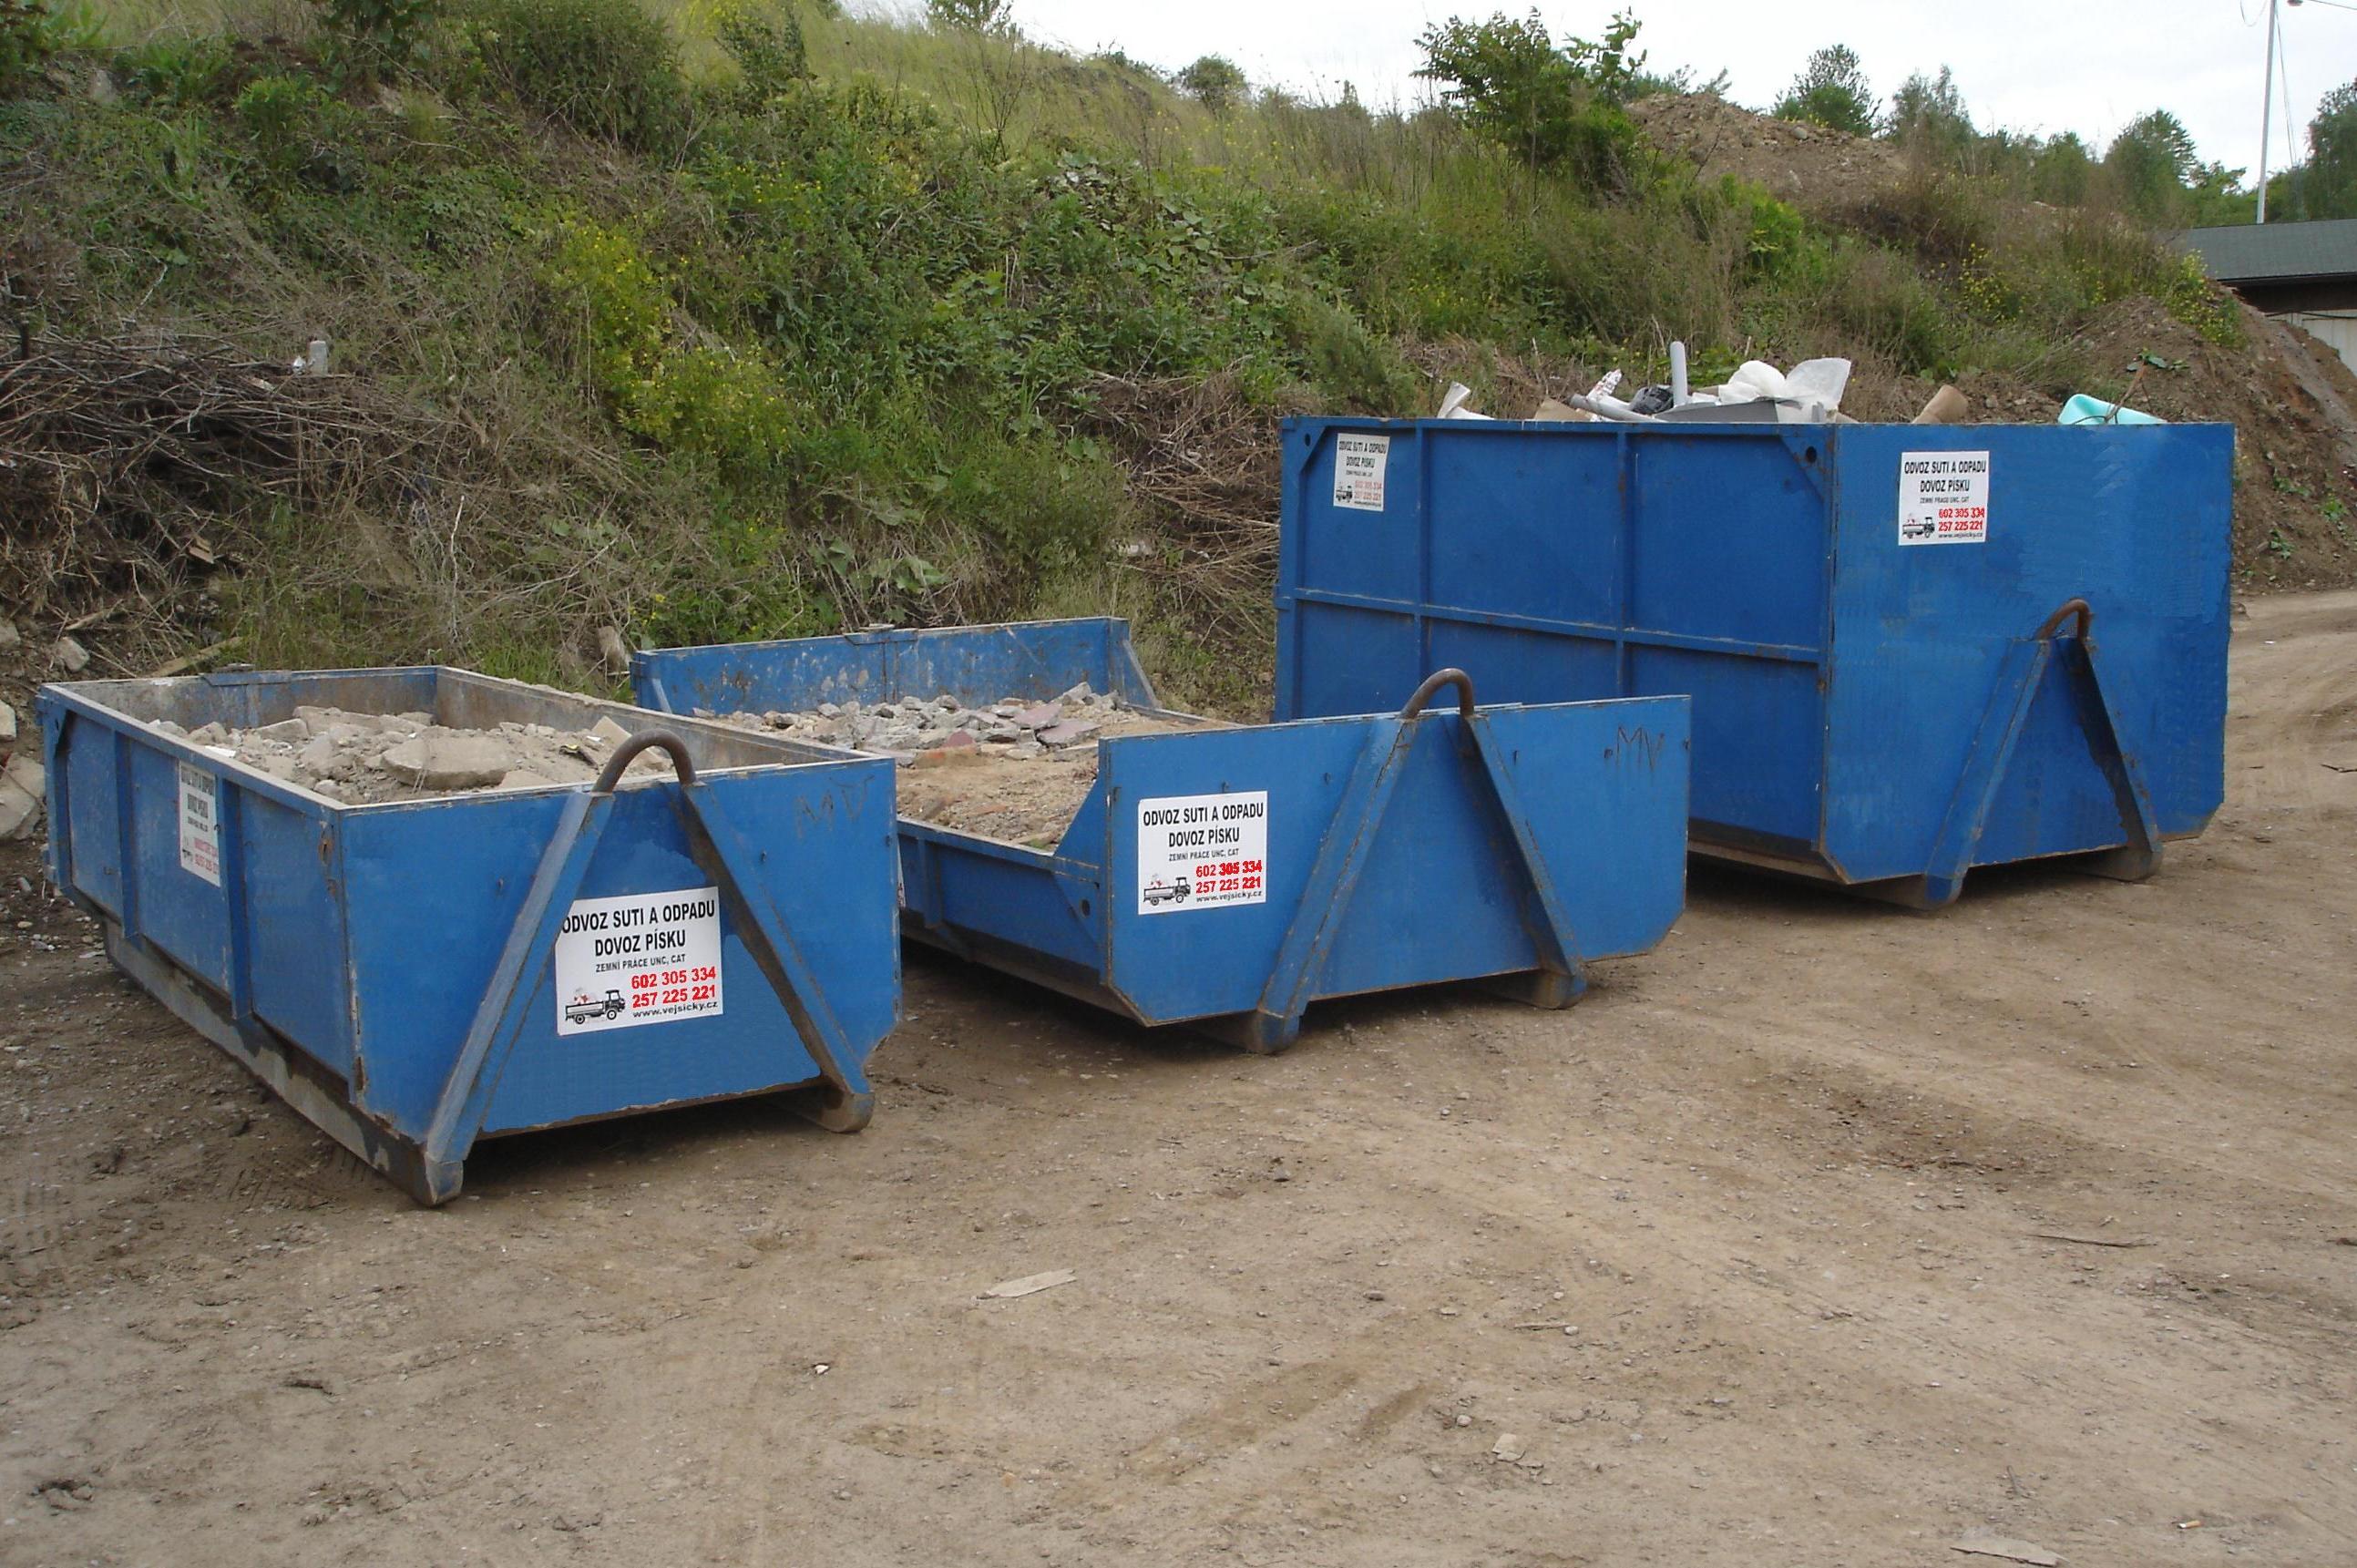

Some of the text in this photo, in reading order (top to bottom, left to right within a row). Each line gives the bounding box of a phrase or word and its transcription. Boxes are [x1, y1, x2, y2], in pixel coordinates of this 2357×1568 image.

[1904, 461, 1986, 473] ODVOZ SUTI A ODPADU
[1920, 480, 1946, 492] DOVOZ
[1939, 508, 1984, 518] 602 305 334
[1939, 521, 1982, 531] 257 225 221
[1143, 803, 1263, 826] ODVOZ SUTI A ODPADU
[1169, 826, 1240, 847] DOVOZ PÍSKU
[1196, 860, 1262, 877] 602 305 334
[1196, 876, 1260, 894] 257 225 221
[562, 900, 715, 933] ODVOZ SUTI A ODPADU
[595, 929, 685, 956] DOVOZ PÍSKU
[671, 954, 685, 963] CAT
[631, 966, 716, 989] 602 305 334
[632, 985, 715, 1008] 257 225 221
[633, 1002, 718, 1018] www.vejsicky.cz
